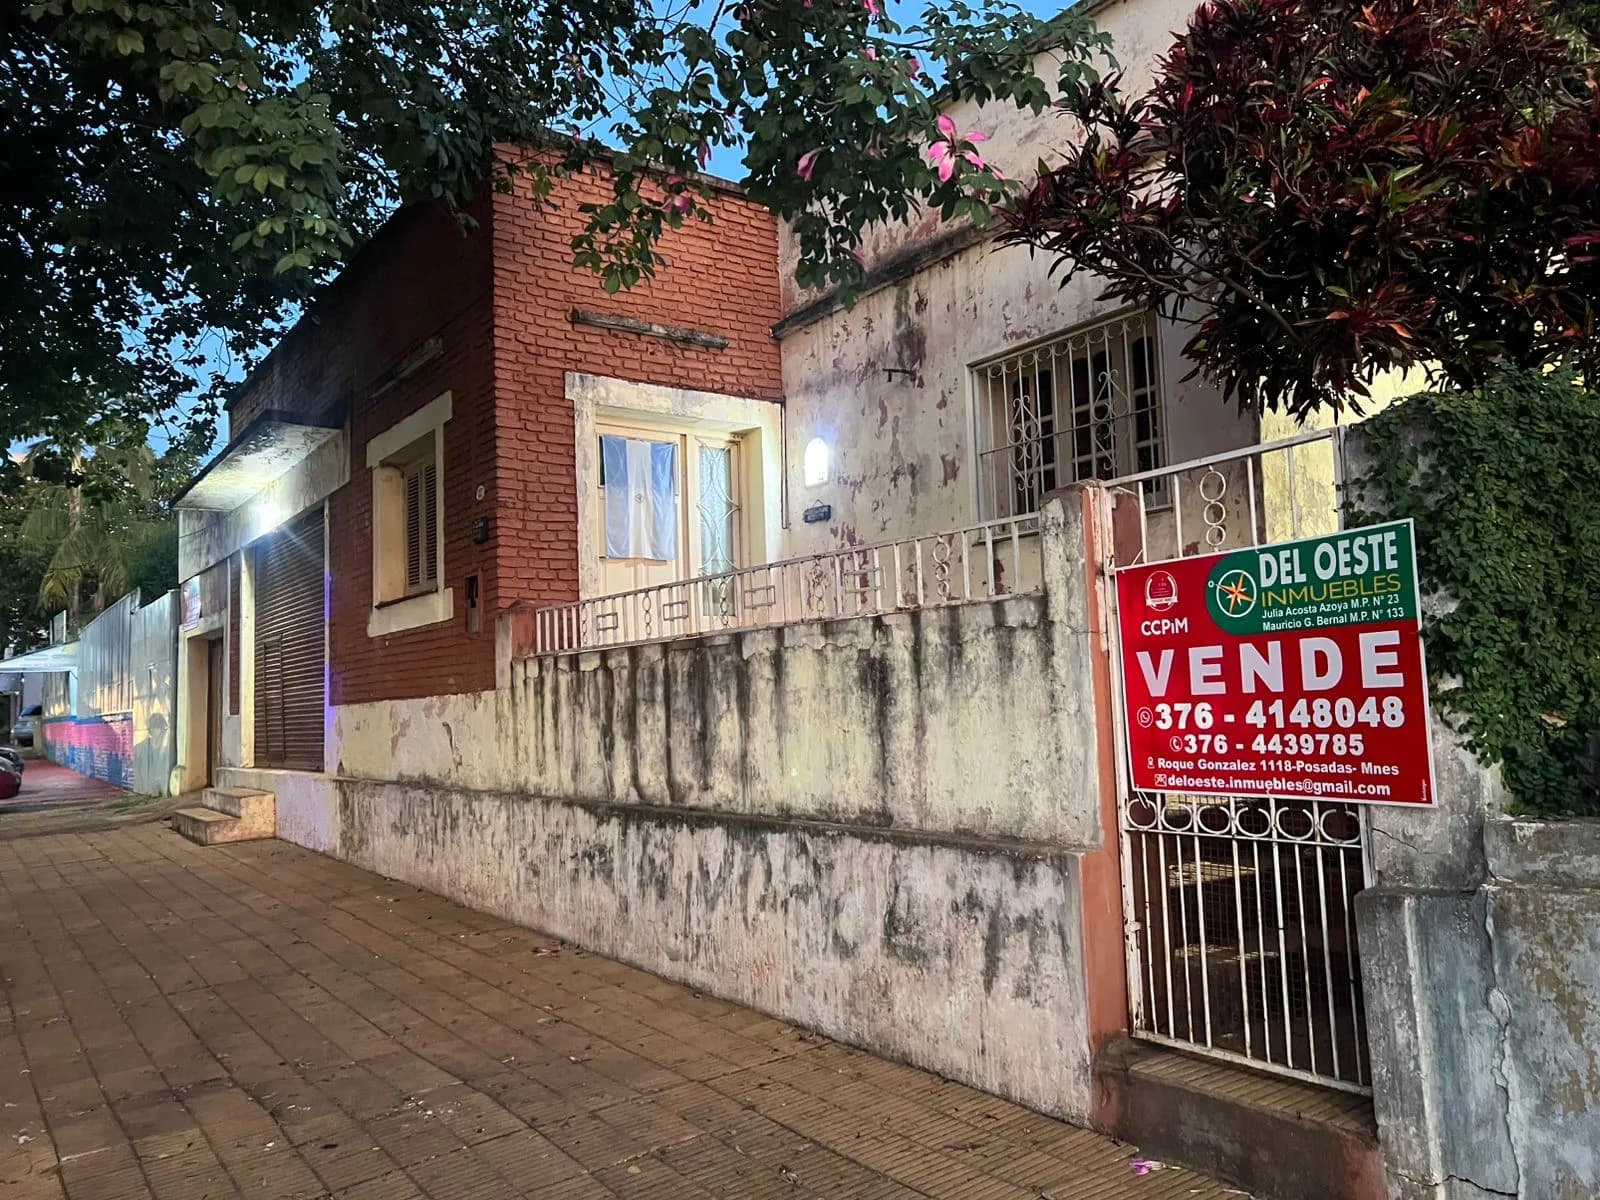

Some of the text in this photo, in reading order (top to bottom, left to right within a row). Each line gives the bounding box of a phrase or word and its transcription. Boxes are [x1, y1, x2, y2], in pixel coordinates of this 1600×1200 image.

[1259, 531, 1399, 588] DEL OESTE
[1262, 573, 1401, 607] INMUEBLES
[1262, 608, 1283, 619] Julia
[1285, 604, 1318, 617] Acosta
[1319, 601, 1348, 613] Azoya
[1350, 597, 1370, 609] M.P.
[1387, 594, 1400, 605] 23
[1141, 617, 1189, 636] CCPiM
[1262, 620, 1302, 632] Mauricio
[1303, 617, 1314, 628] G.
[1316, 613, 1348, 626] Bernal
[1349, 611, 1370, 623] M.P.
[1386, 607, 1405, 619] 133
[1135, 630, 1405, 698] VENDE
[1155, 696, 1405, 730] 376 - 4148048
[1184, 734, 1228, 754] 376
[1251, 733, 1364, 756] 4439785
[1157, 757, 1194, 772] Roque
[1198, 759, 1256, 772] Gonzalez
[1361, 762, 1400, 776] Mnes
[1168, 774, 1391, 796] deloeste.inmuebles@gmail.com
